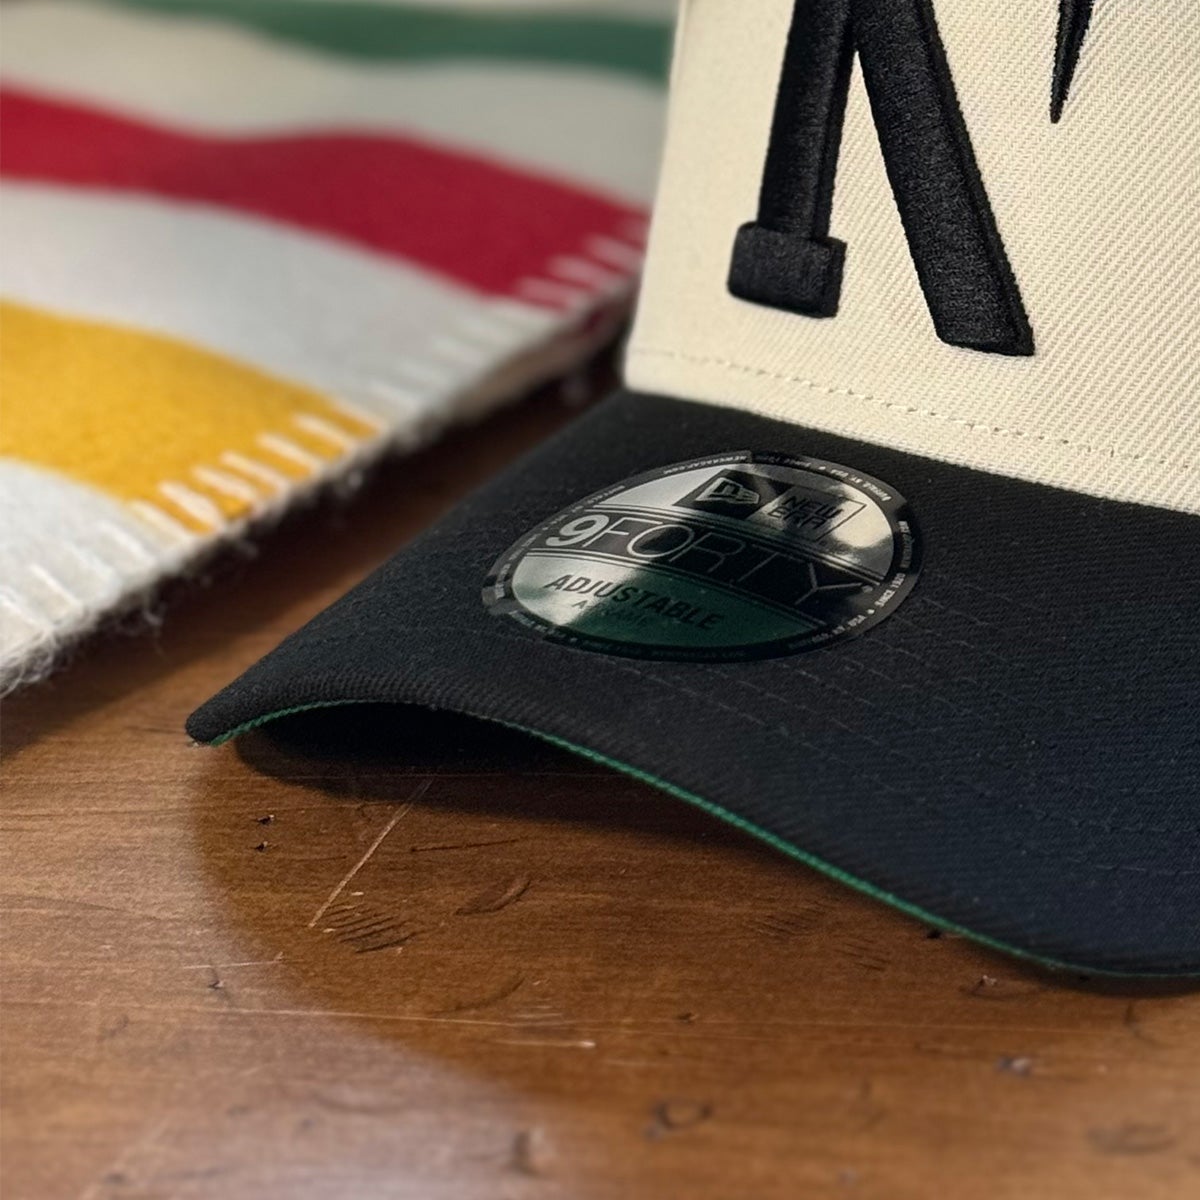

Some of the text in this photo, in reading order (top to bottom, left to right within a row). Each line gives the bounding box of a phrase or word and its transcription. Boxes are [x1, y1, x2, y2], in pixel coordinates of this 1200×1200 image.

[767, 505, 829, 530] ERA
[783, 495, 844, 519] NEW
[545, 514, 865, 606] 9FORTY
[543, 574, 725, 630] ADJUSTABLE
